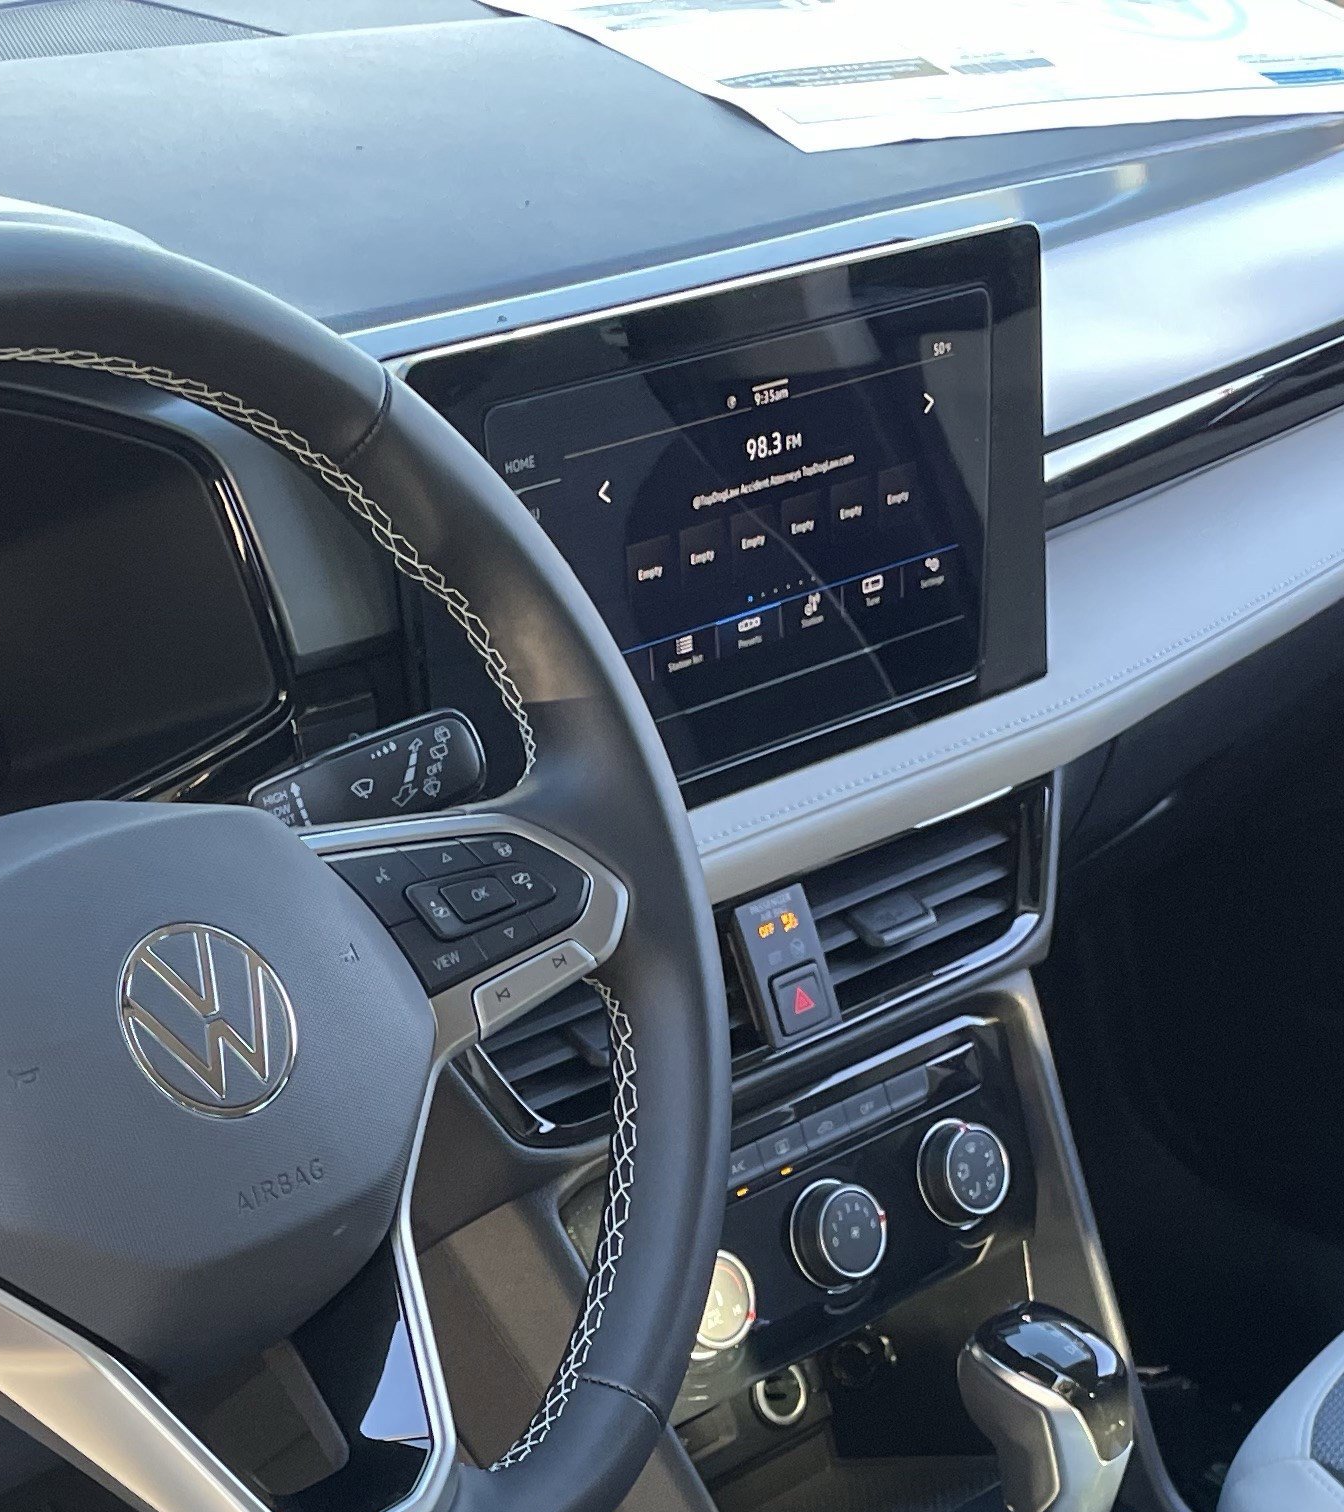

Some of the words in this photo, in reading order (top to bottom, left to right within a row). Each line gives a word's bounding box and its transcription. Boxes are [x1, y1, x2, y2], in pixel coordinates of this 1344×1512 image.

[754, 387, 789, 407] 9:35am
[746, 431, 783, 461] 98.3
[785, 433, 802, 450] FM
[504, 455, 535, 474] HOME
[887, 491, 909, 506] Empty
[840, 505, 863, 521] Empty
[791, 520, 815, 535] Empty
[741, 535, 766, 550] Empty
[690, 550, 715, 565] Empty
[638, 566, 663, 581] Empty
[262, 791, 289, 807] HIGH
[471, 886, 490, 901] OK
[432, 950, 460, 971] VIEW
[238, 1158, 324, 1214] AIRBAG
